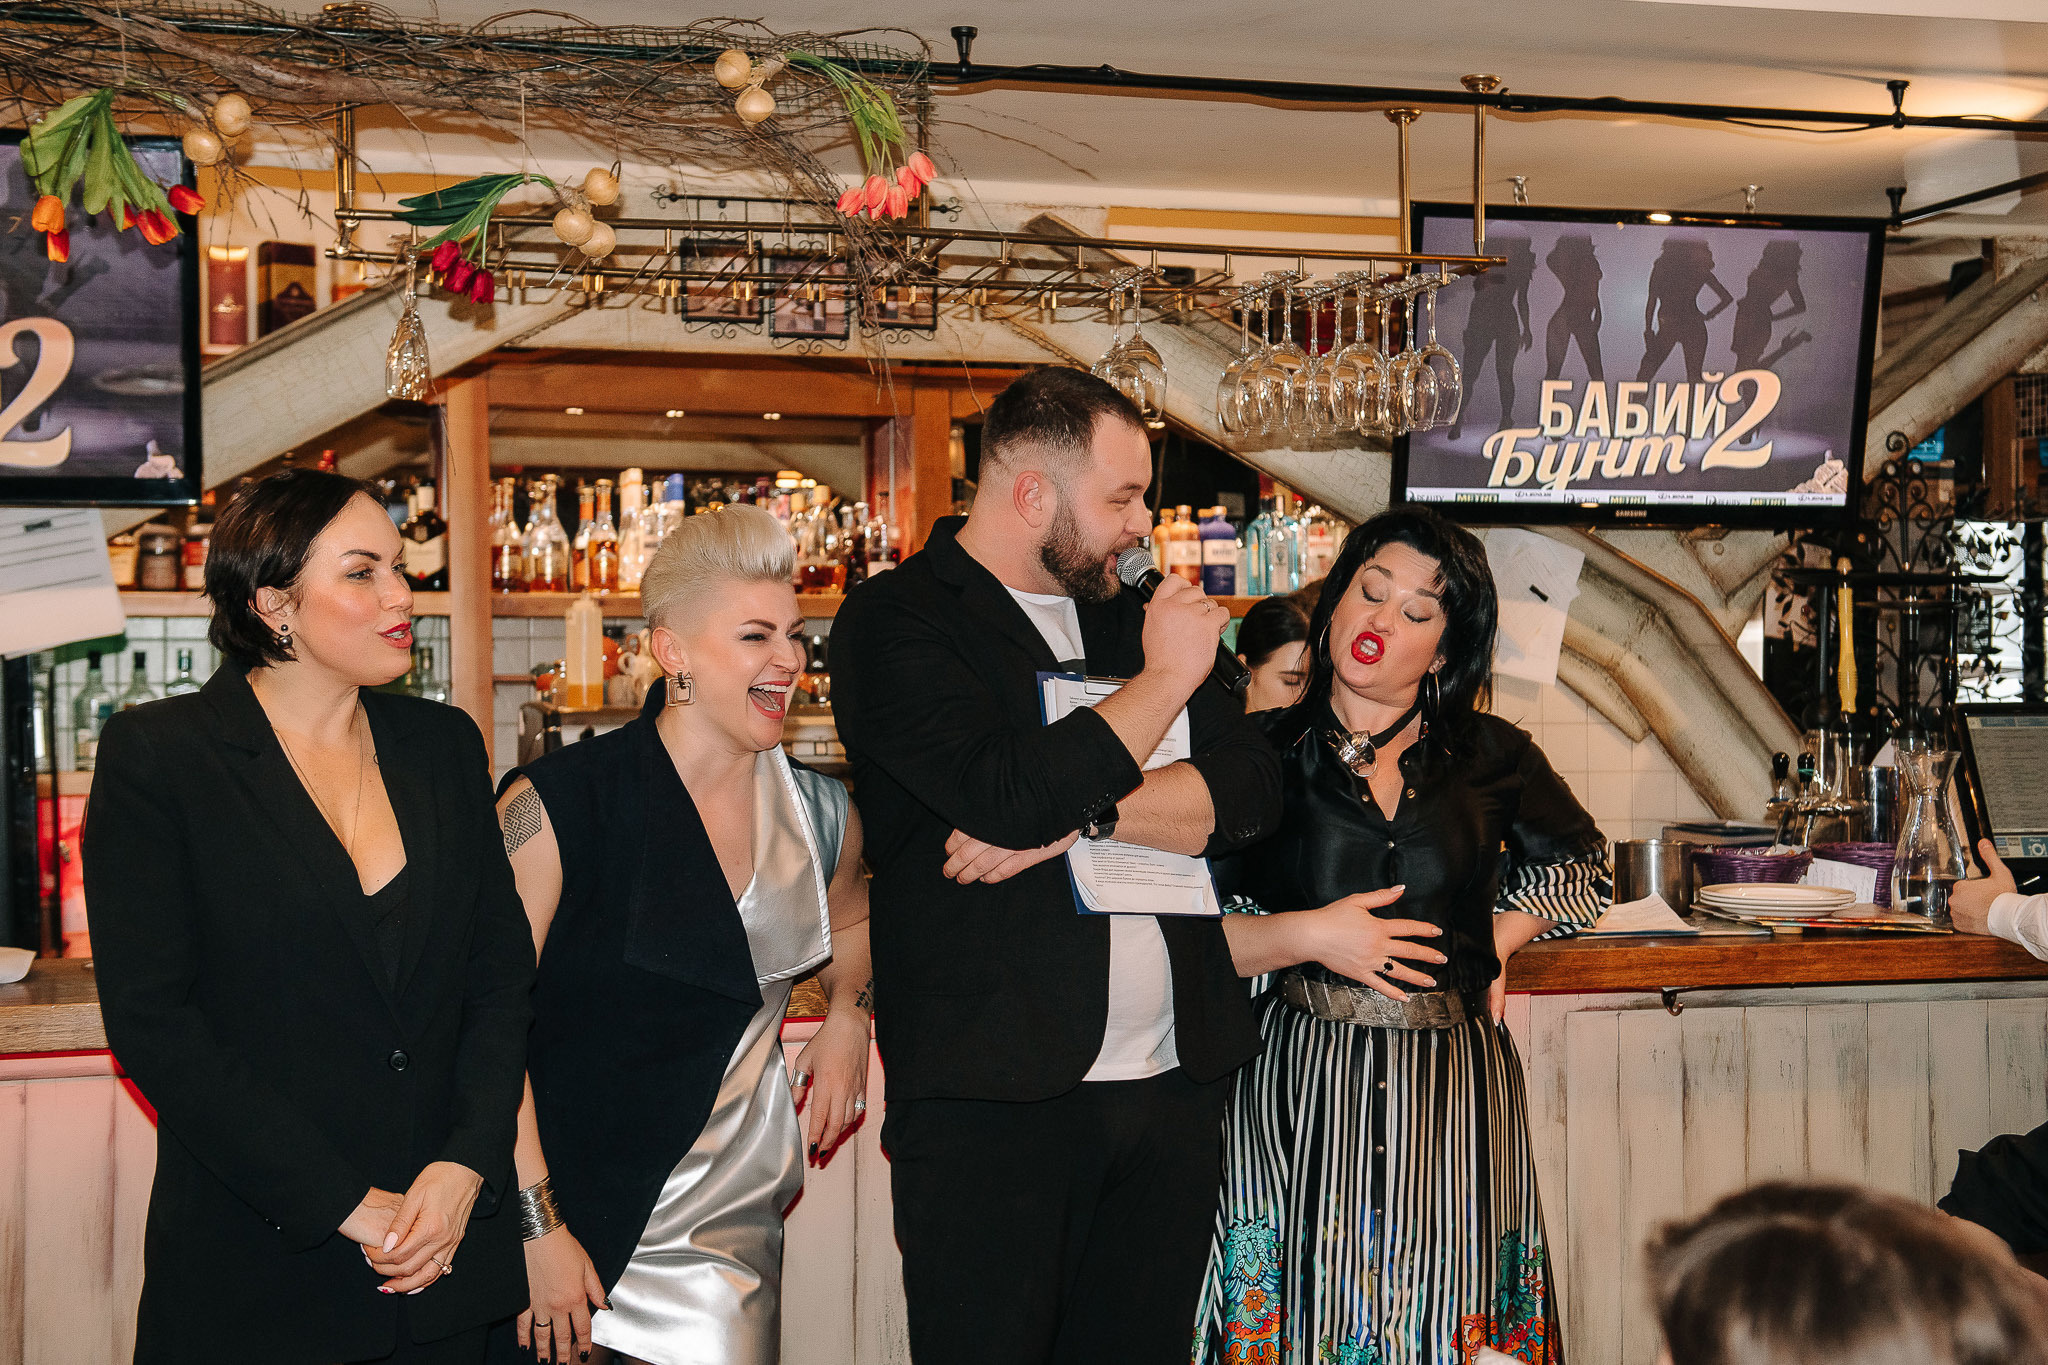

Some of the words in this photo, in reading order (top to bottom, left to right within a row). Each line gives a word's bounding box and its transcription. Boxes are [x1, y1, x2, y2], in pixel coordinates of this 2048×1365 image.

[0, 317, 75, 468] 2
[1539, 371, 1727, 440] БАБИЙ
[1701, 369, 1782, 472] 2
[1483, 425, 1686, 492] Бунт
